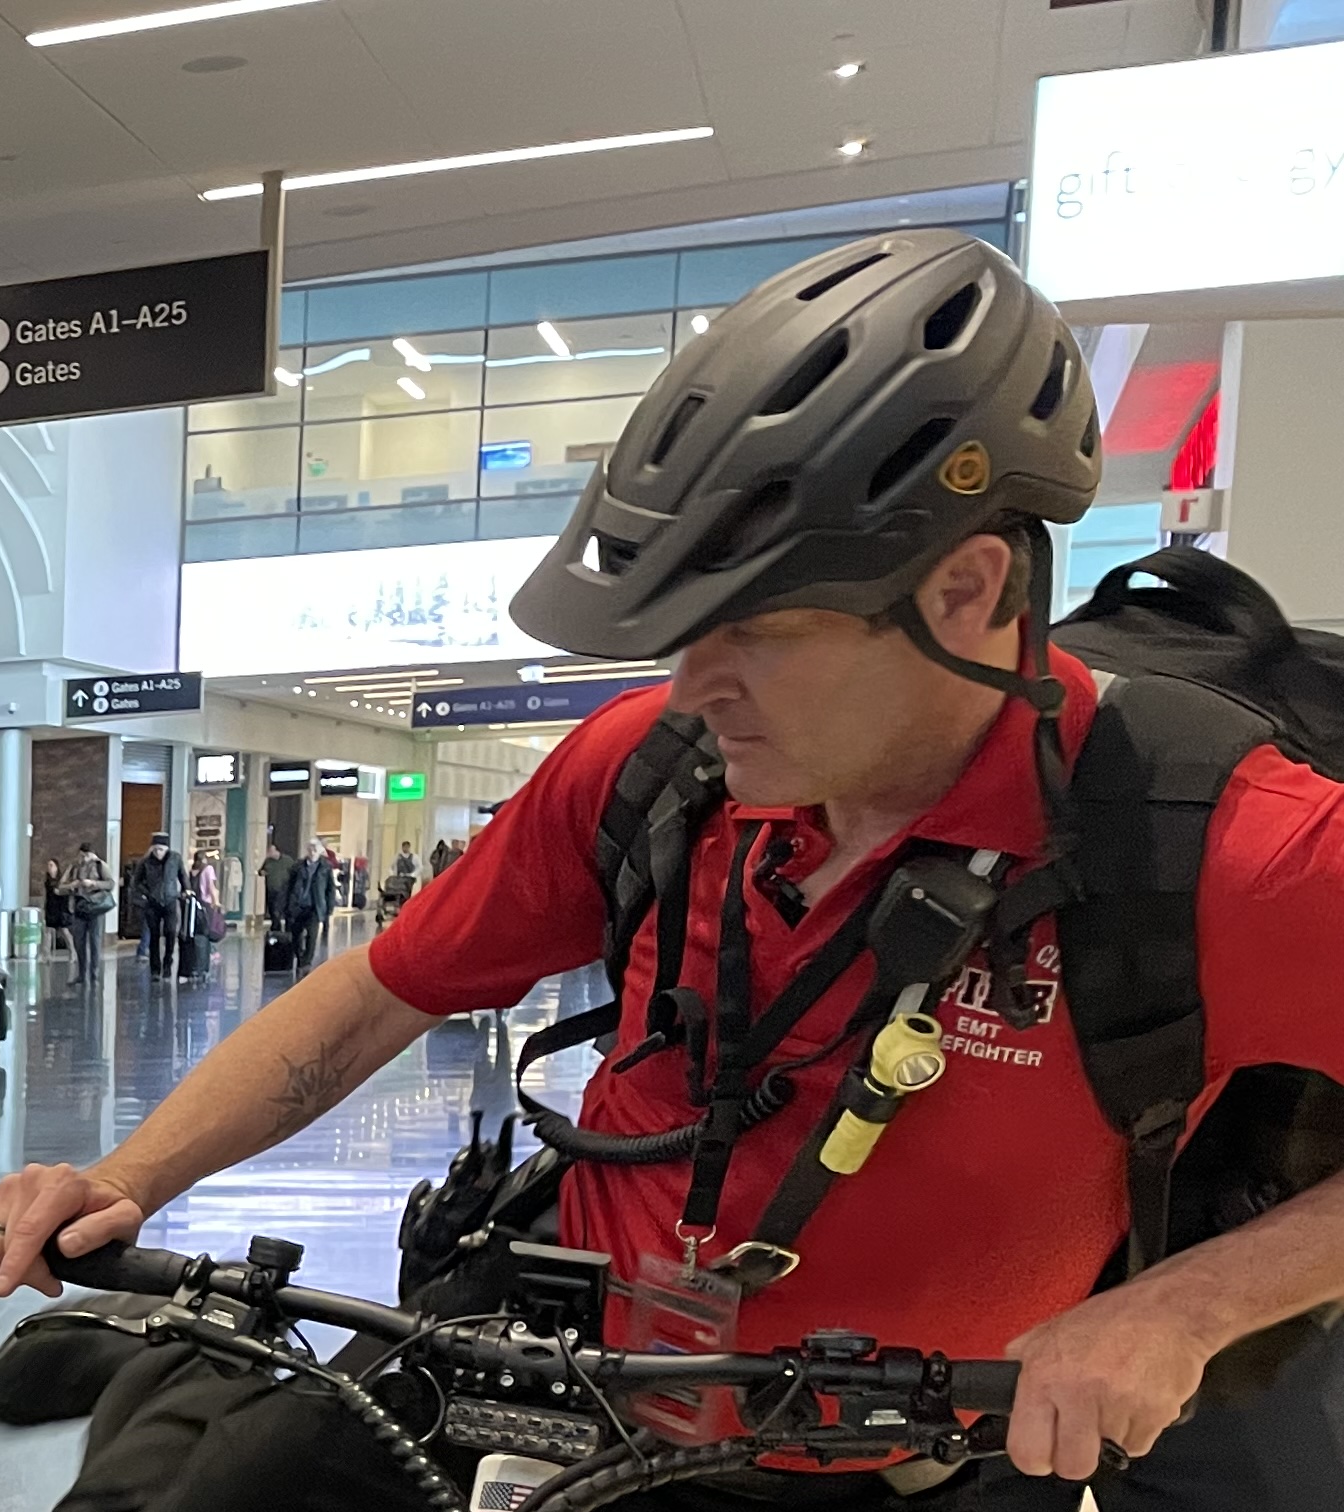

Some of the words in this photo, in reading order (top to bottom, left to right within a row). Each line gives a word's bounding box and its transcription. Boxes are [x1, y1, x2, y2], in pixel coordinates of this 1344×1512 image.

[14, 318, 83, 345] Gates
[14, 360, 82, 387] Gates
[957, 1015, 1003, 1039] EMT
[941, 1035, 1043, 1067] EFIGHTER
